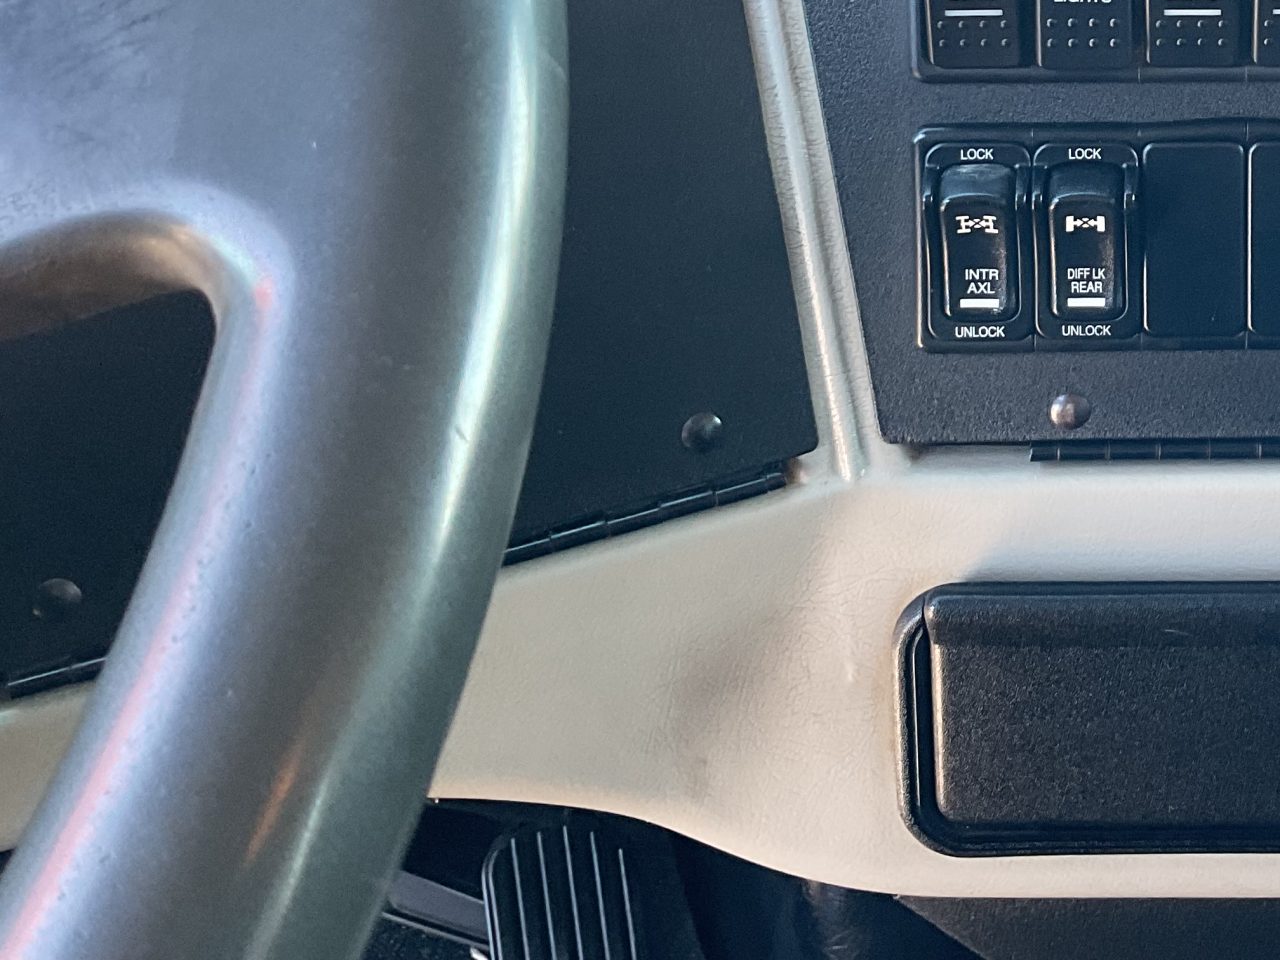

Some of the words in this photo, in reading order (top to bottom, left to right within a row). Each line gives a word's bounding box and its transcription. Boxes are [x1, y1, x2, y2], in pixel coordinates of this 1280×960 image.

[960, 148, 994, 161] LOCK
[1068, 147, 1102, 160] LOCK
[964, 268, 999, 281] INTR
[1067, 267, 1091, 280] DIFF
[1092, 267, 1106, 280] LK
[966, 281, 996, 295] AXL
[1070, 280, 1103, 294] REAR
[954, 325, 1006, 338] UNLOCK
[1061, 324, 1112, 337] UNLOCK
